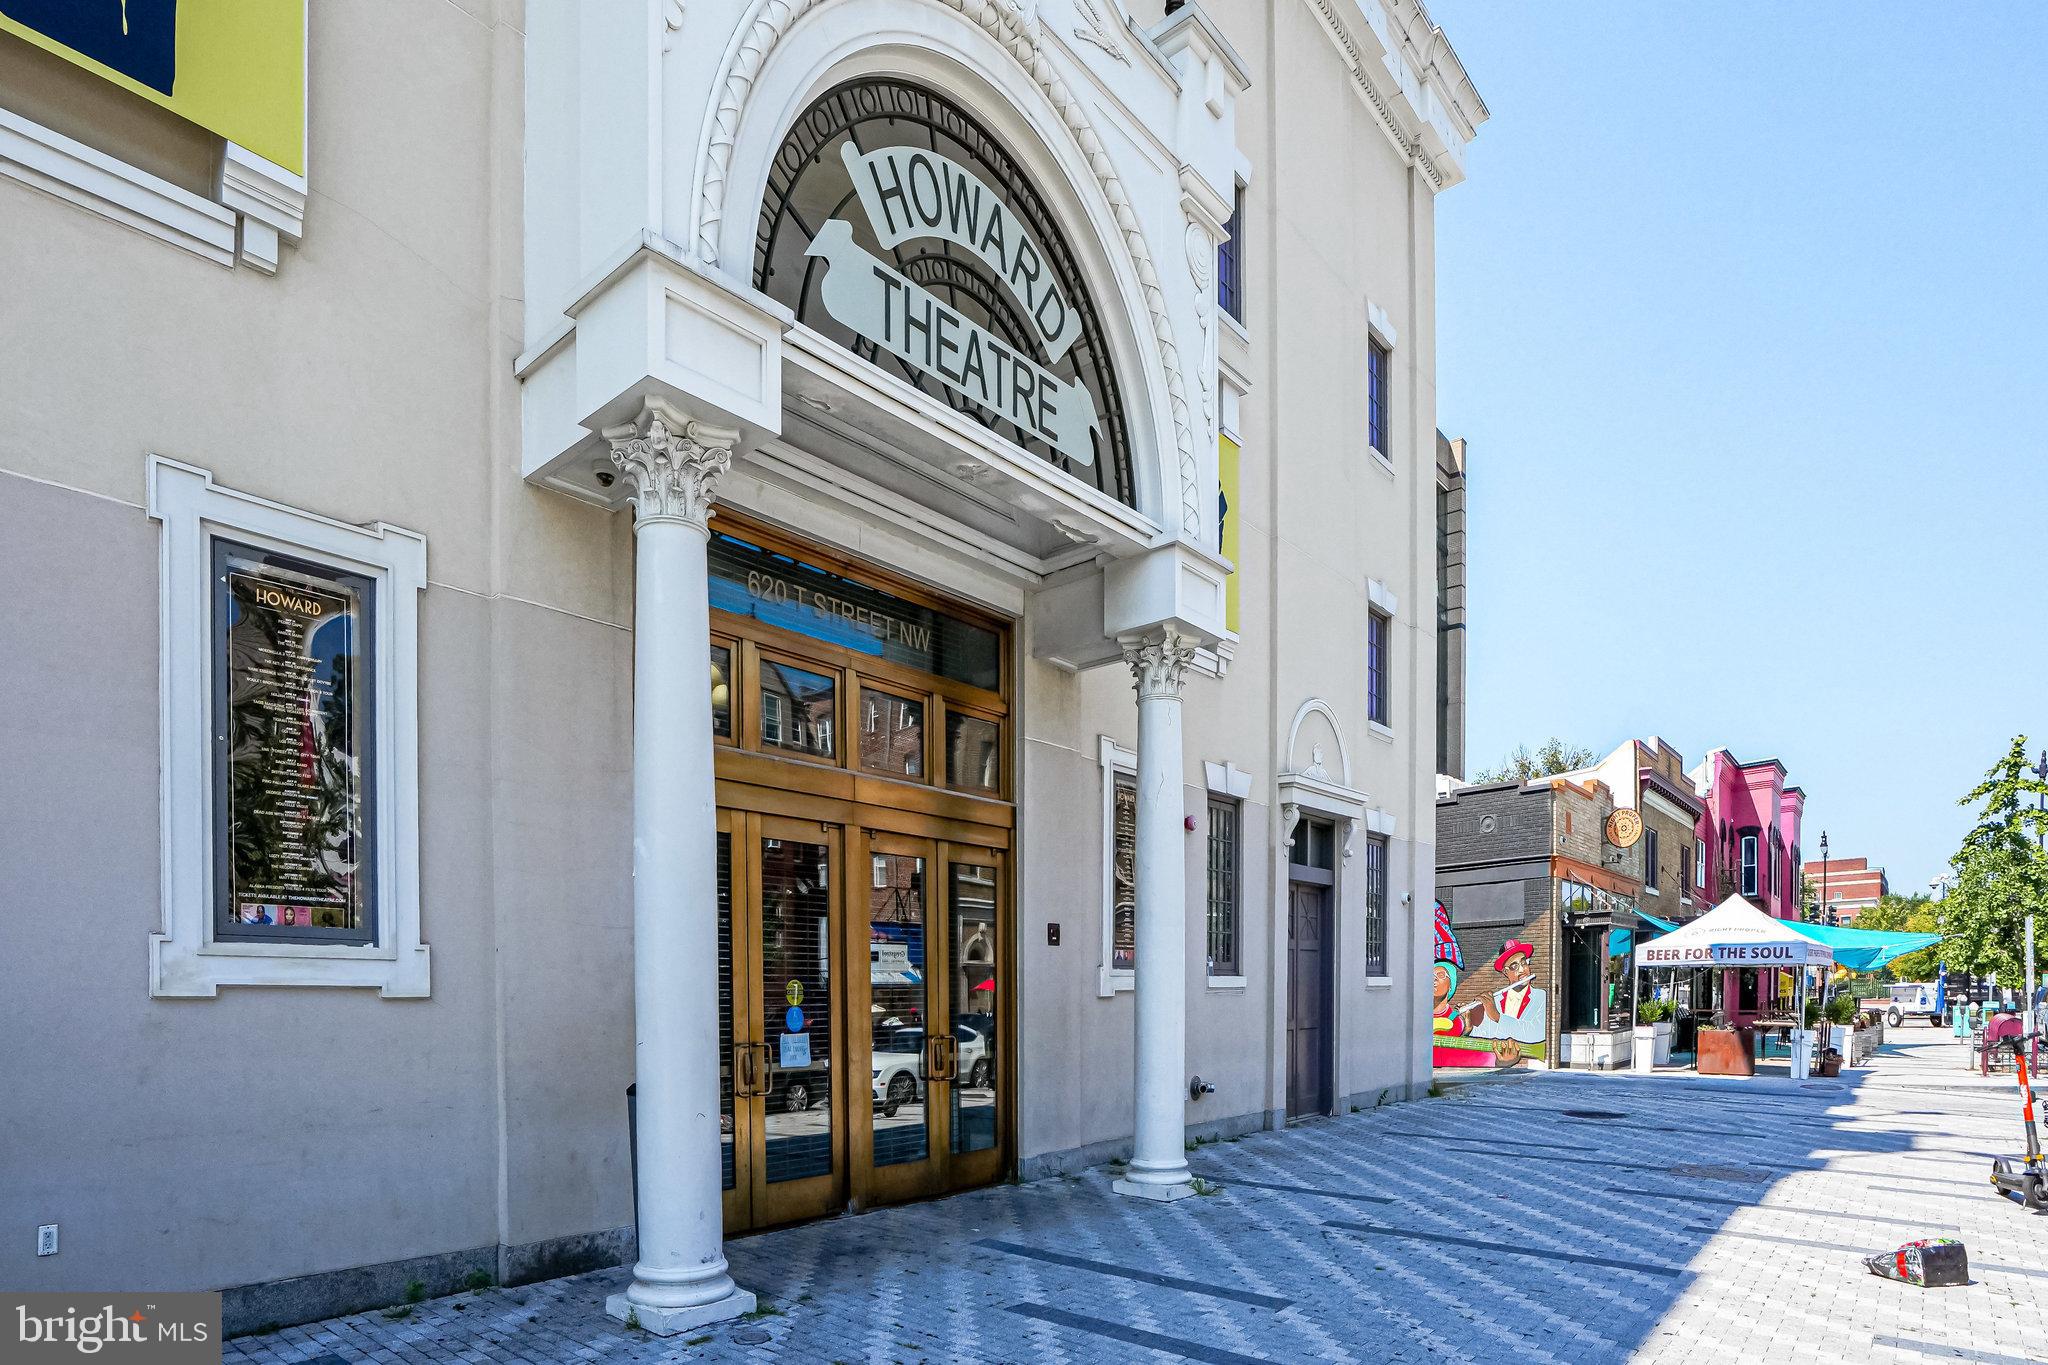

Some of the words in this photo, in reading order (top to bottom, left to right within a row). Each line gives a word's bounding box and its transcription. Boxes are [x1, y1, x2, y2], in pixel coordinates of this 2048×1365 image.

[868, 153, 1066, 342] HOWARD
[873, 265, 1058, 442] THEATRE
[256, 588, 322, 616] HOWARD
[747, 570, 787, 605] 620
[792, 585, 807, 610] T
[813, 592, 894, 640] STREET
[899, 623, 932, 652] NW
[1647, 949, 1681, 961] BEER
[1684, 948, 1714, 960] FOR
[1718, 947, 1746, 959] THE
[1750, 946, 1793, 959] SOUL
